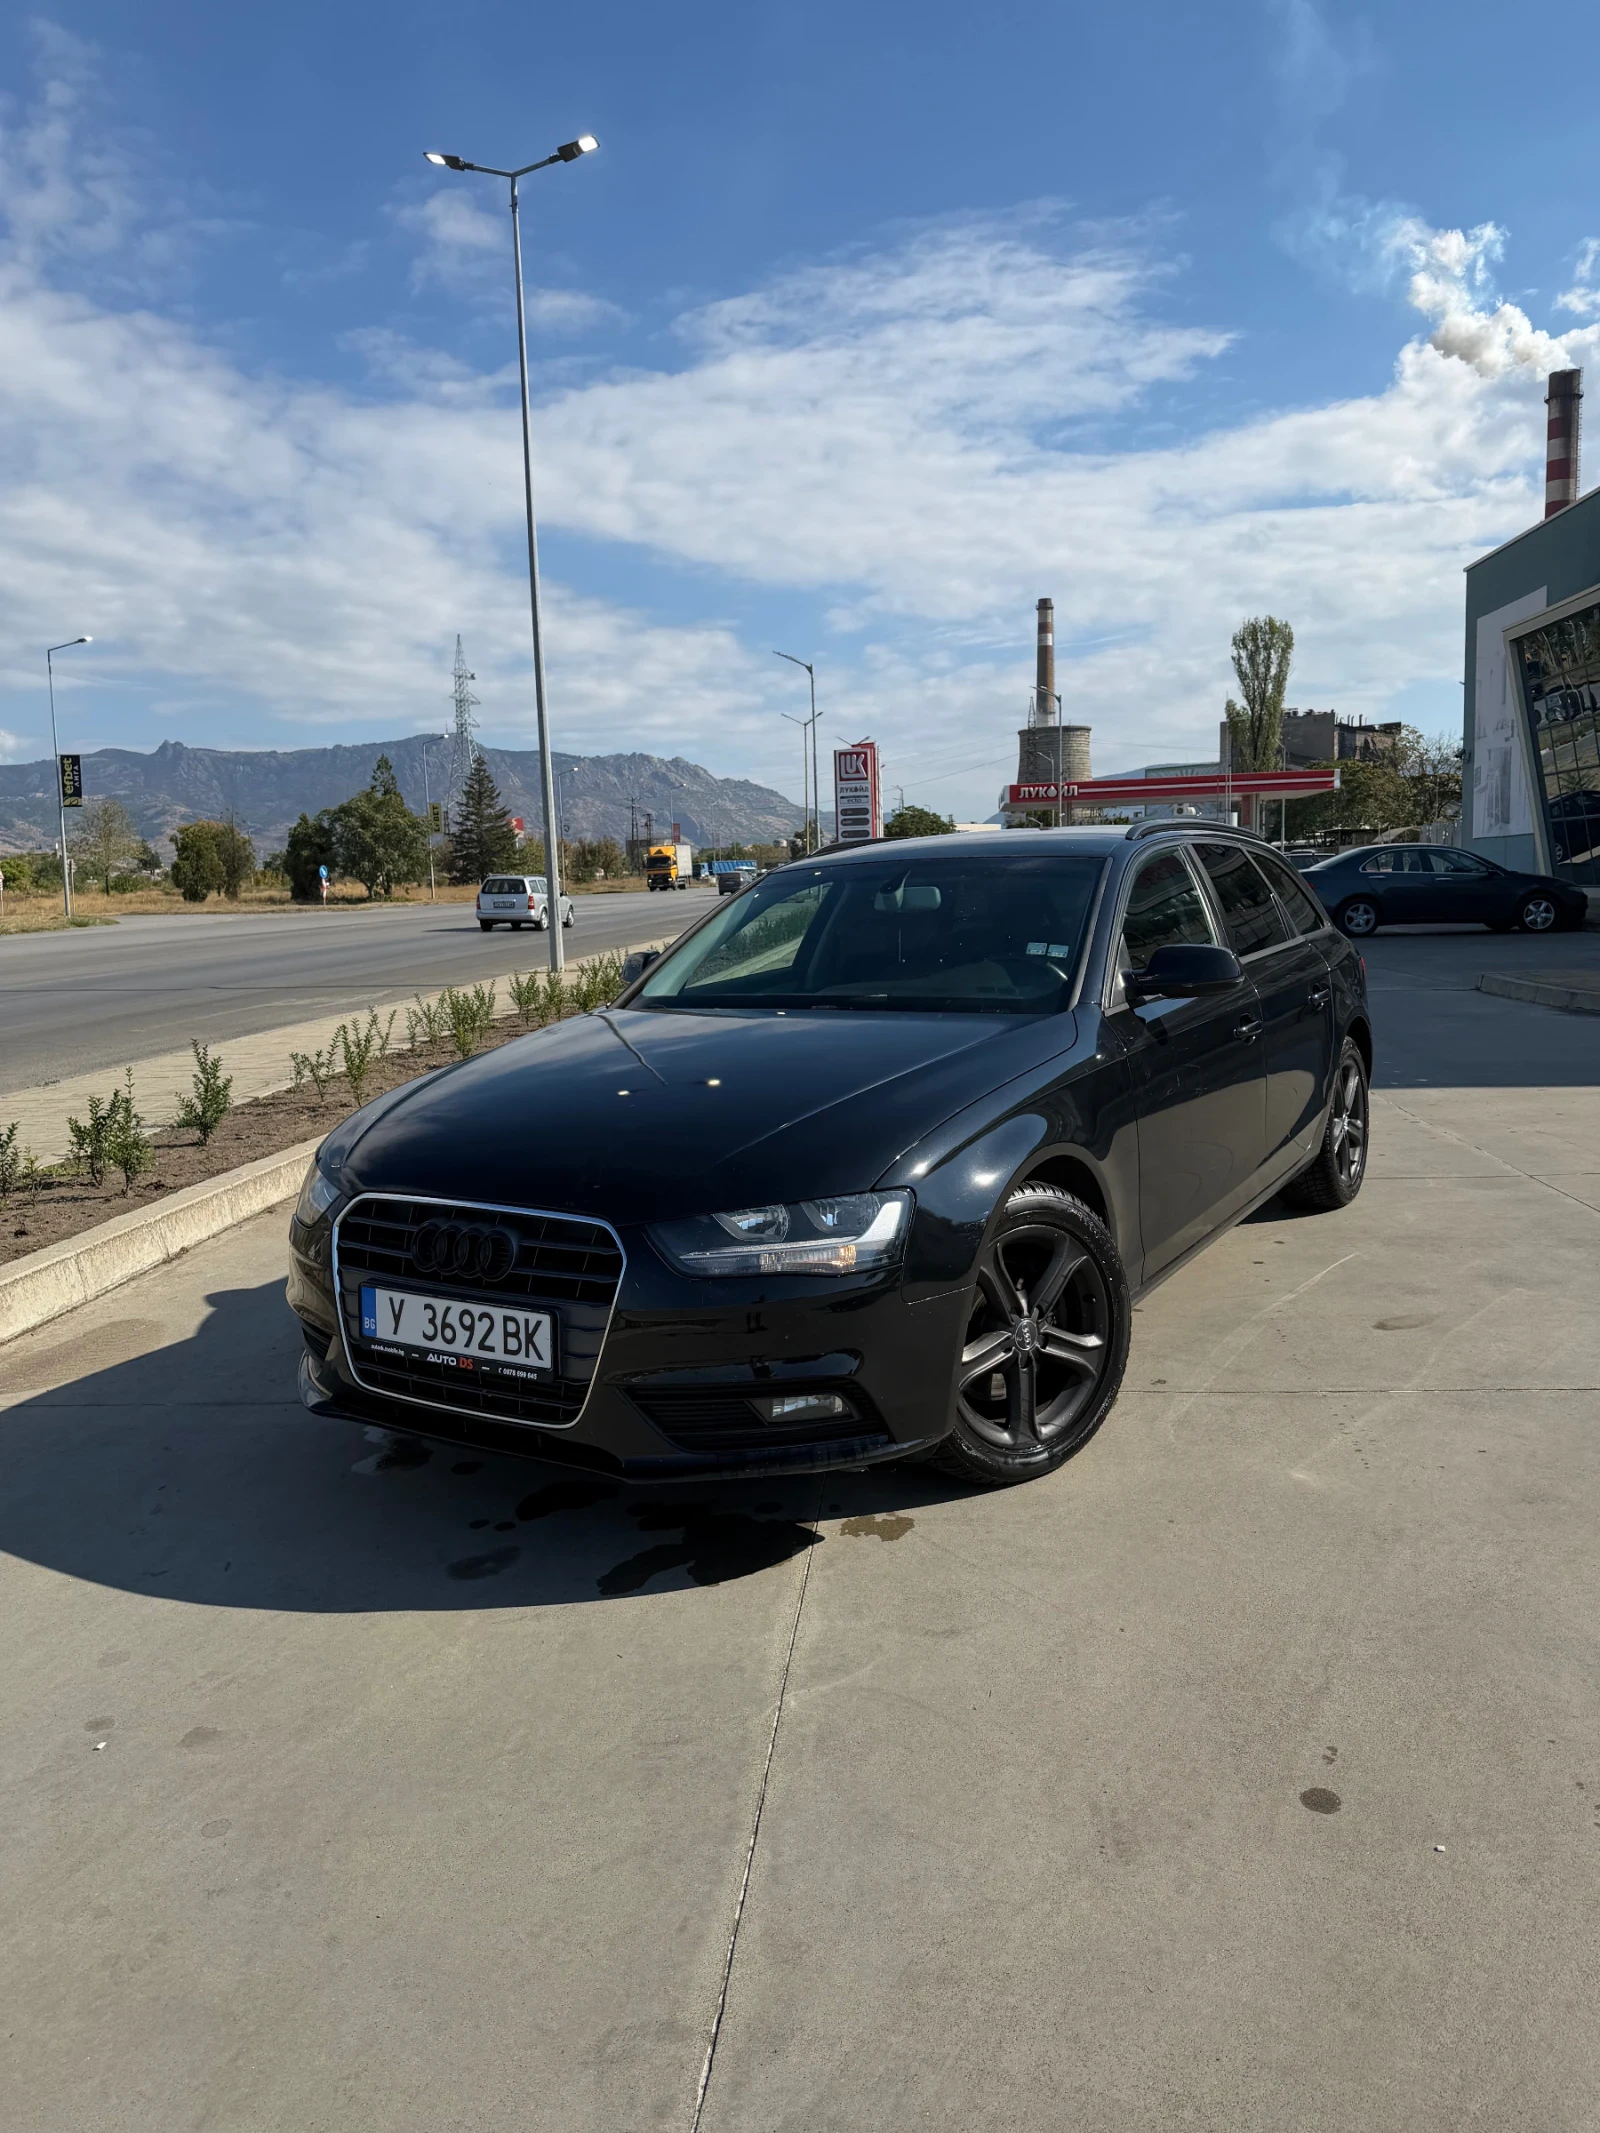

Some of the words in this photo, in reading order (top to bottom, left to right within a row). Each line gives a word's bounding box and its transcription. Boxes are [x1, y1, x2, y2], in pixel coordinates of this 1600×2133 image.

[63, 757, 74, 795] efbet
[364, 1316, 376, 1329] BG
[426, 1353, 457, 1366] AUTO
[459, 1357, 474, 1370] DS
